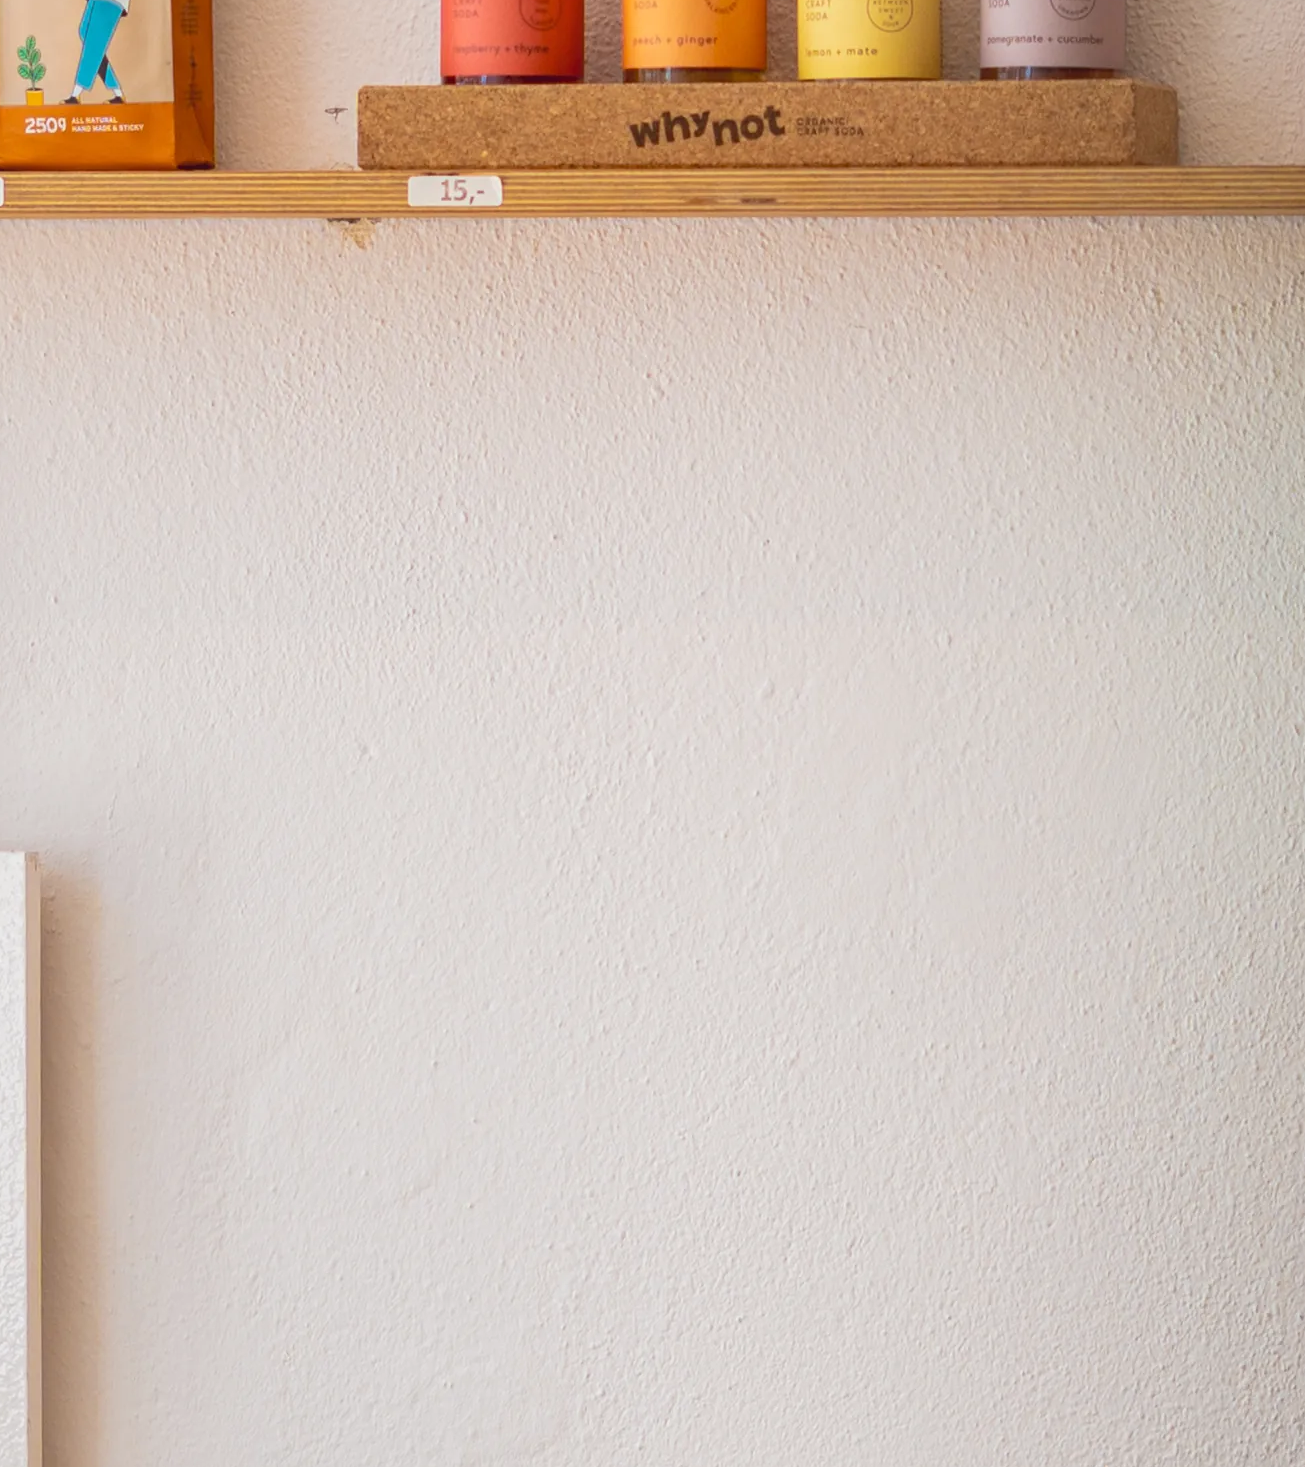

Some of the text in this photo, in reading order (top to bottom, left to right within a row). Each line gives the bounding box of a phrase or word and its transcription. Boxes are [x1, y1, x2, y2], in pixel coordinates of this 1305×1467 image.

[806, 0, 831, 8] CRAFT
[988, 0, 1010, 8] SODA
[806, 12, 828, 21] SODA
[633, 35, 661, 46] peach
[677, 35, 718, 47] ginger
[987, 34, 1043, 46] pomegranate
[1057, 34, 1104, 45] cucumber
[514, 44, 549, 56] thyme
[805, 47, 831, 57] lemon
[847, 47, 878, 56] mate
[24, 117, 67, 134] 250g
[835, 126, 864, 136] SODA
[441, 179, 485, 205] 15,-
